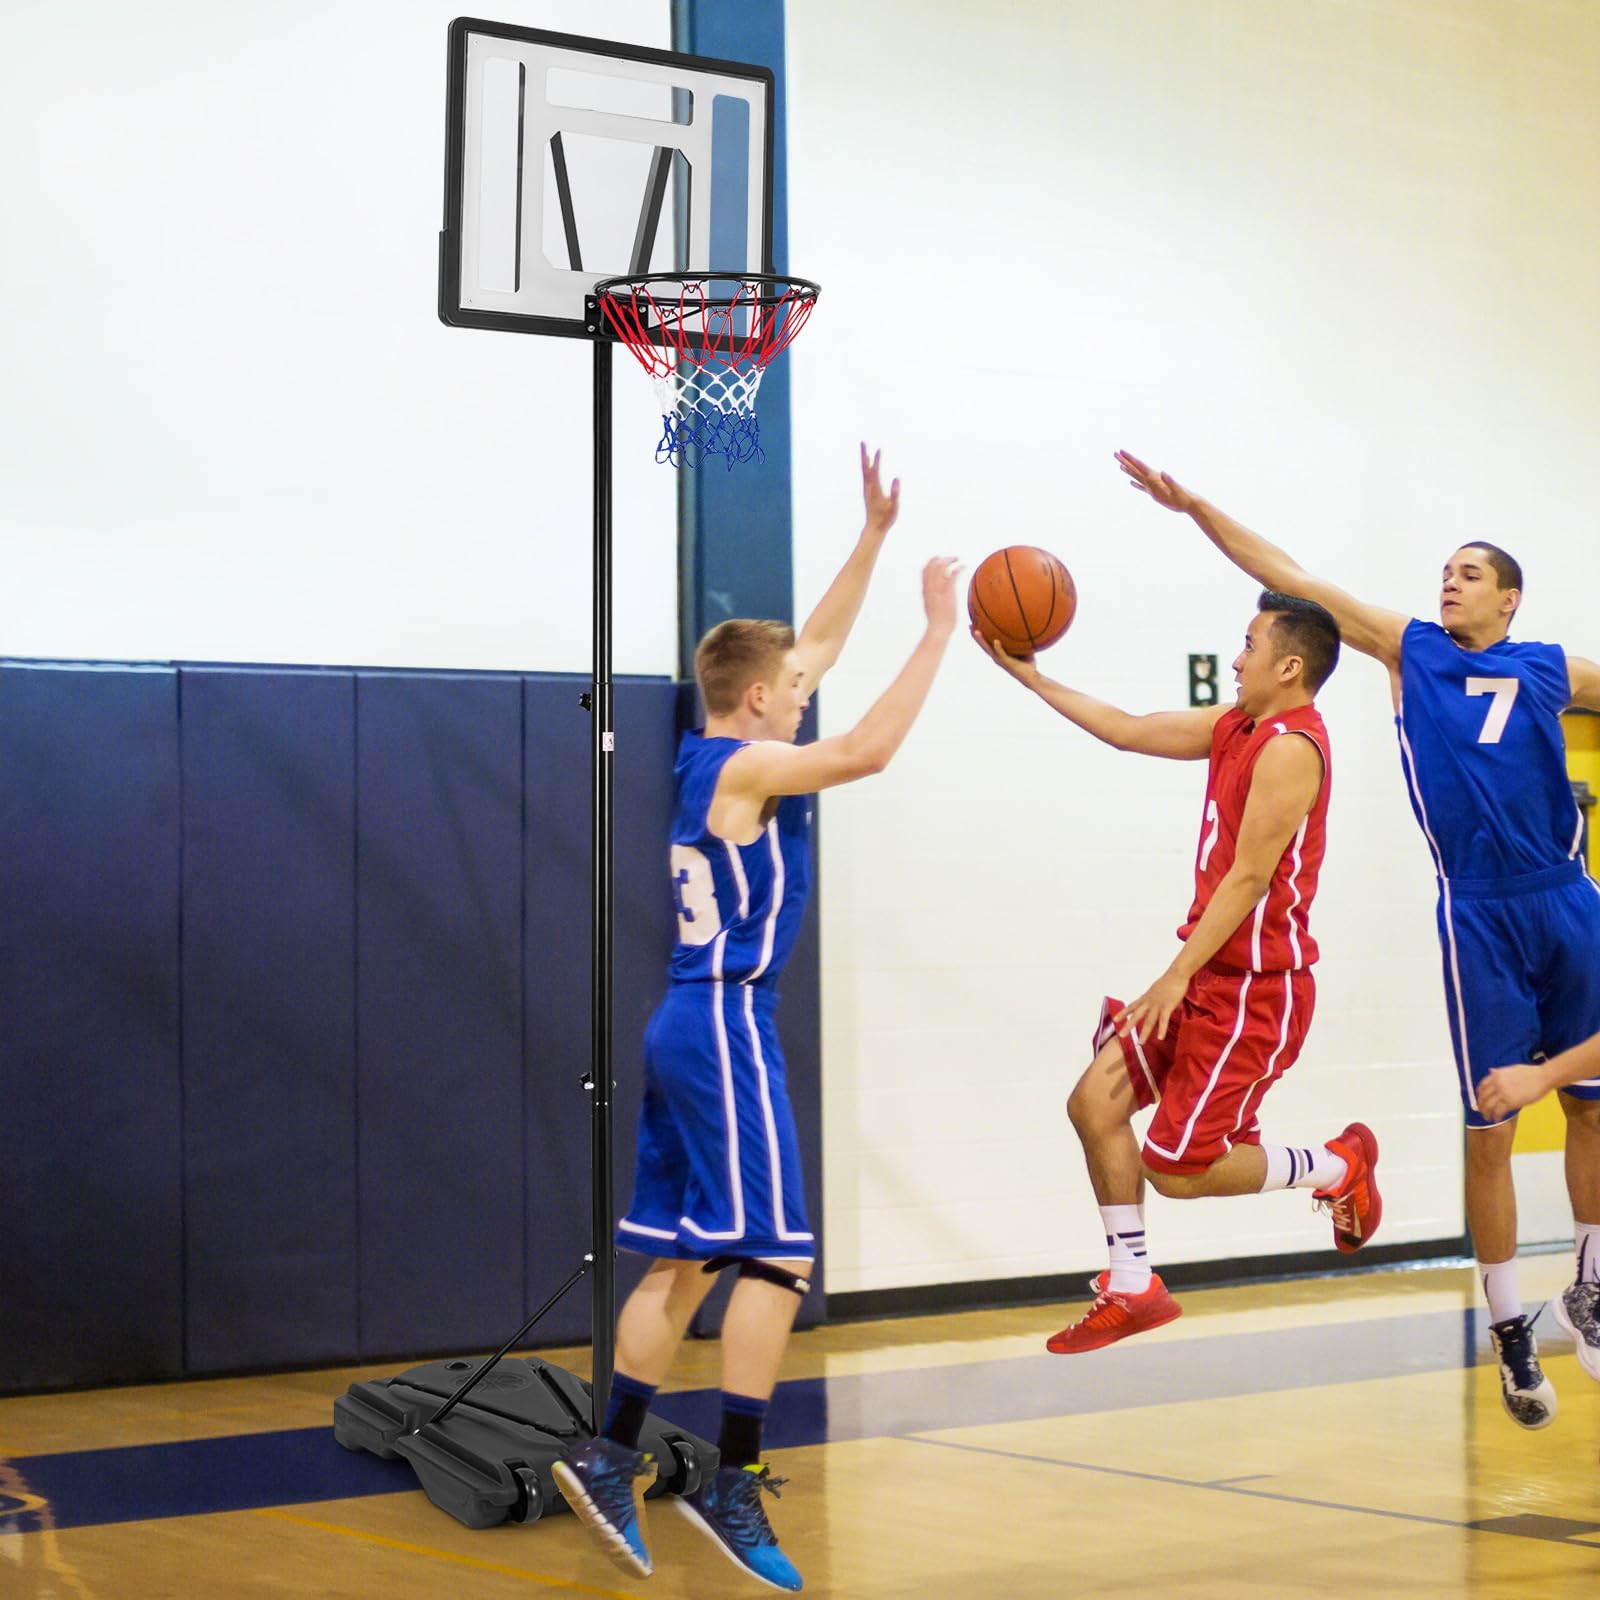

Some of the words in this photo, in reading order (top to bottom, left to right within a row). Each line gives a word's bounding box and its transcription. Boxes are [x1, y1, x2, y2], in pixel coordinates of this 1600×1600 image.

[1188, 654, 1218, 707] B
[1465, 677, 1519, 743] 7
[670, 844, 722, 946] 3
